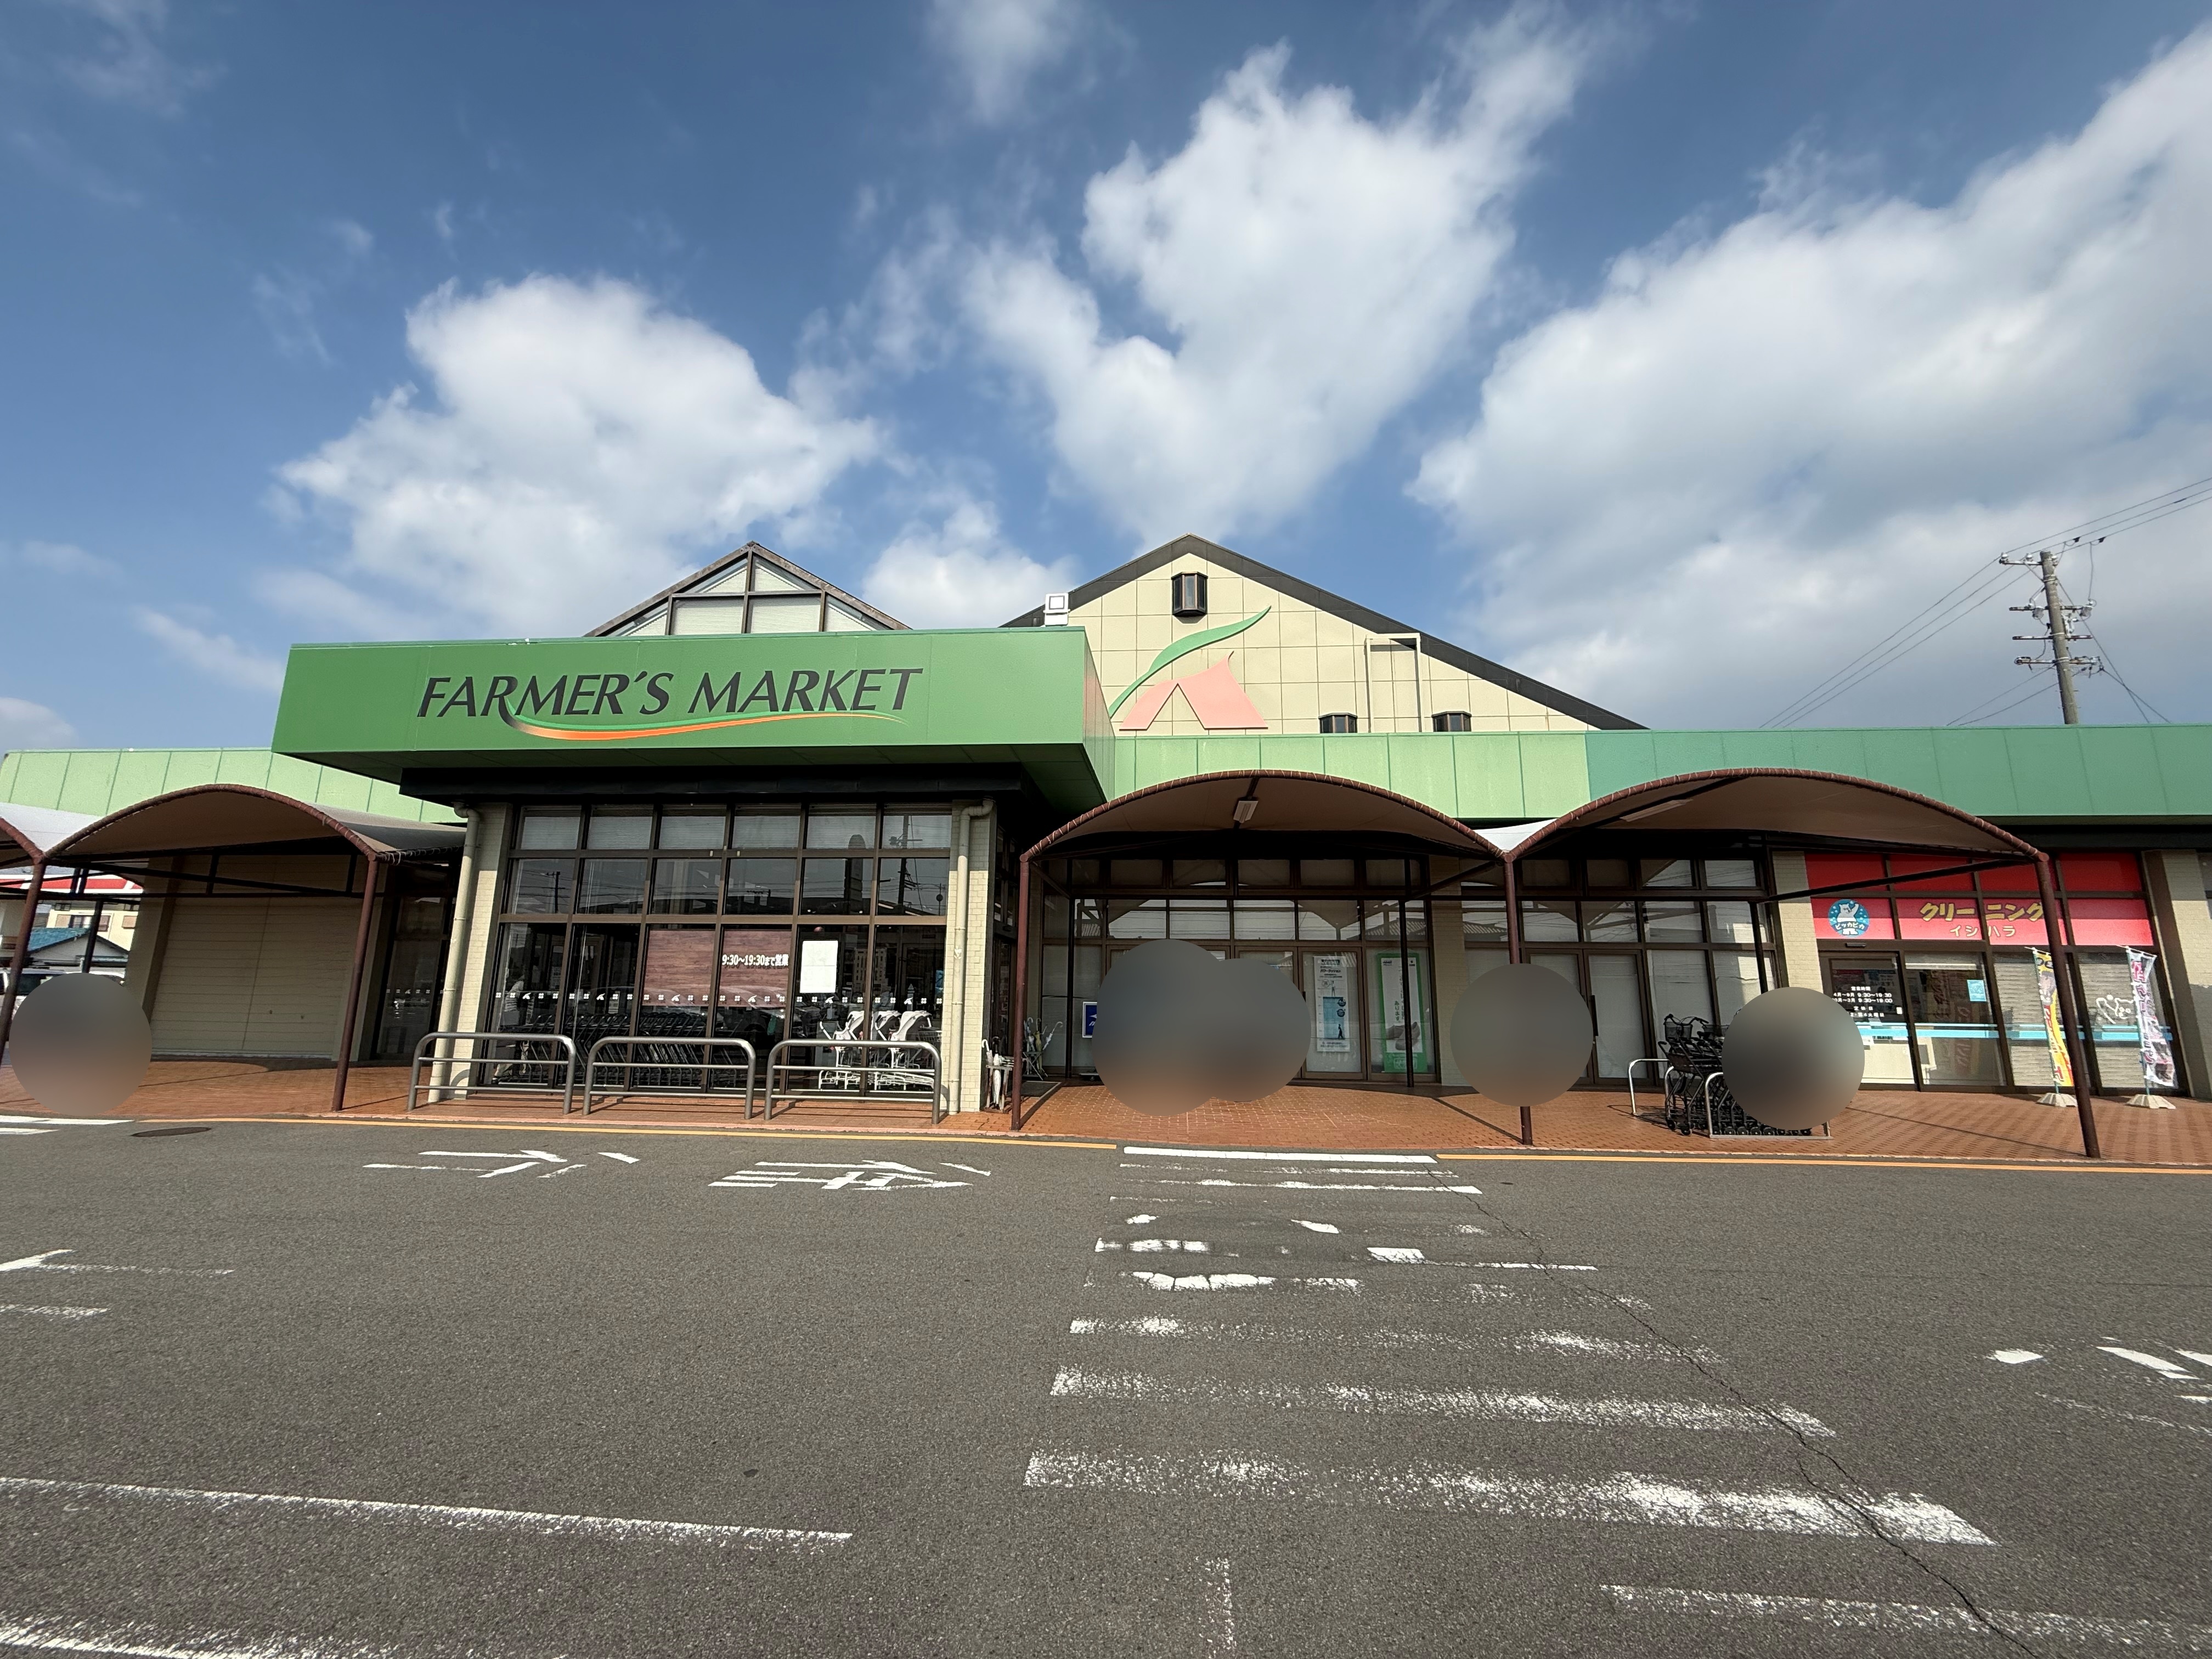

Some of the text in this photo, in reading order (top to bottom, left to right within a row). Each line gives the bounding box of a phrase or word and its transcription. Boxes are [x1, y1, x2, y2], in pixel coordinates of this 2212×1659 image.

[417, 668, 923, 719] FARMER'S MARKET
[1920, 902, 2043, 921] クリーニング
[1950, 925, 2016, 937] イシハラ
